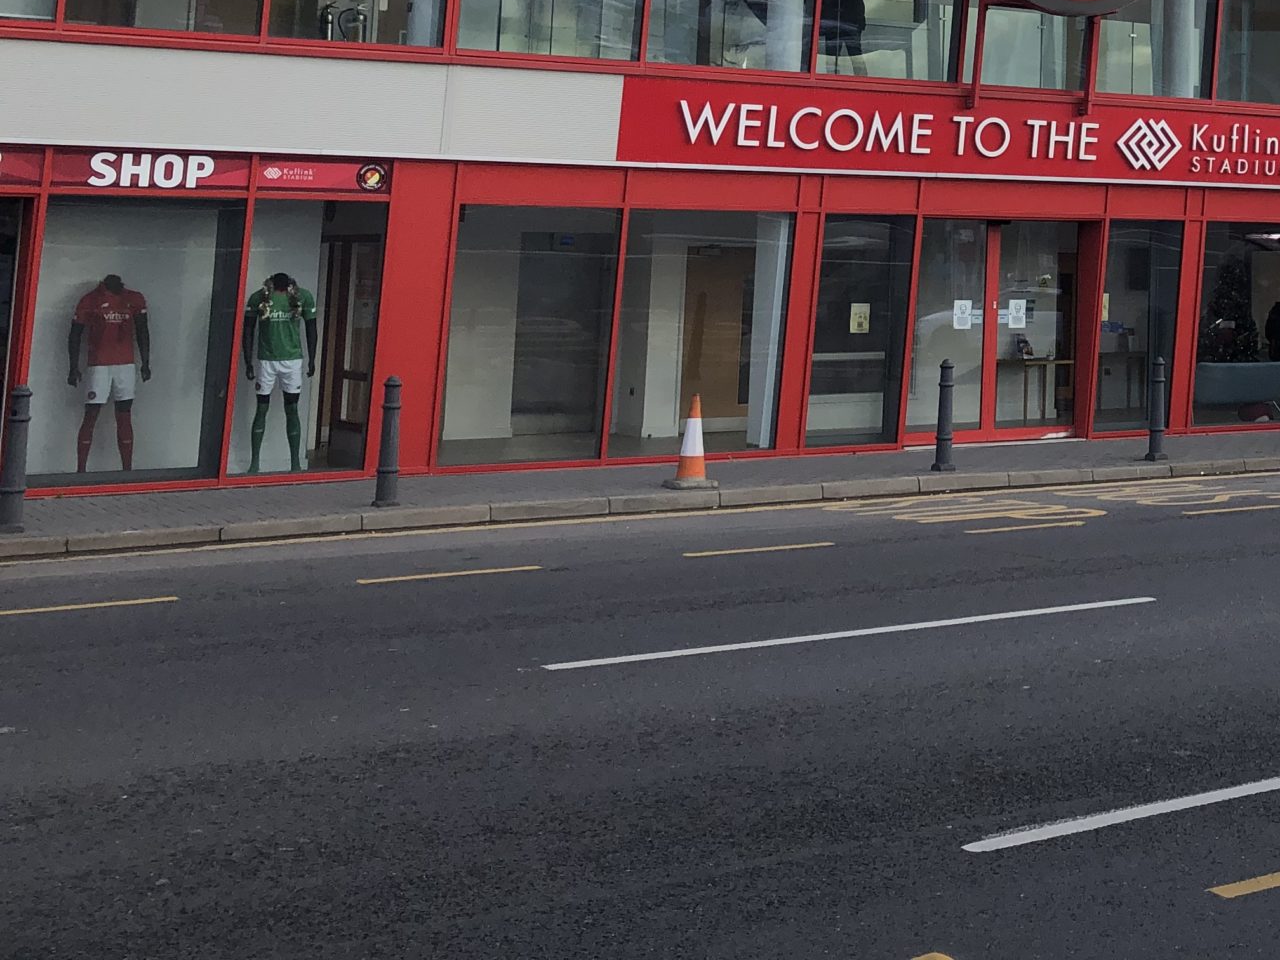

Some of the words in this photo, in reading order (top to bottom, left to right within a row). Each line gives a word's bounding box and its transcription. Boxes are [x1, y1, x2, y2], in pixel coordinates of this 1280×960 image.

[680, 100, 934, 154] WELCOME
[953, 116, 1011, 159] TO
[1027, 119, 1100, 161] THE
[88, 152, 215, 189] SHOP
